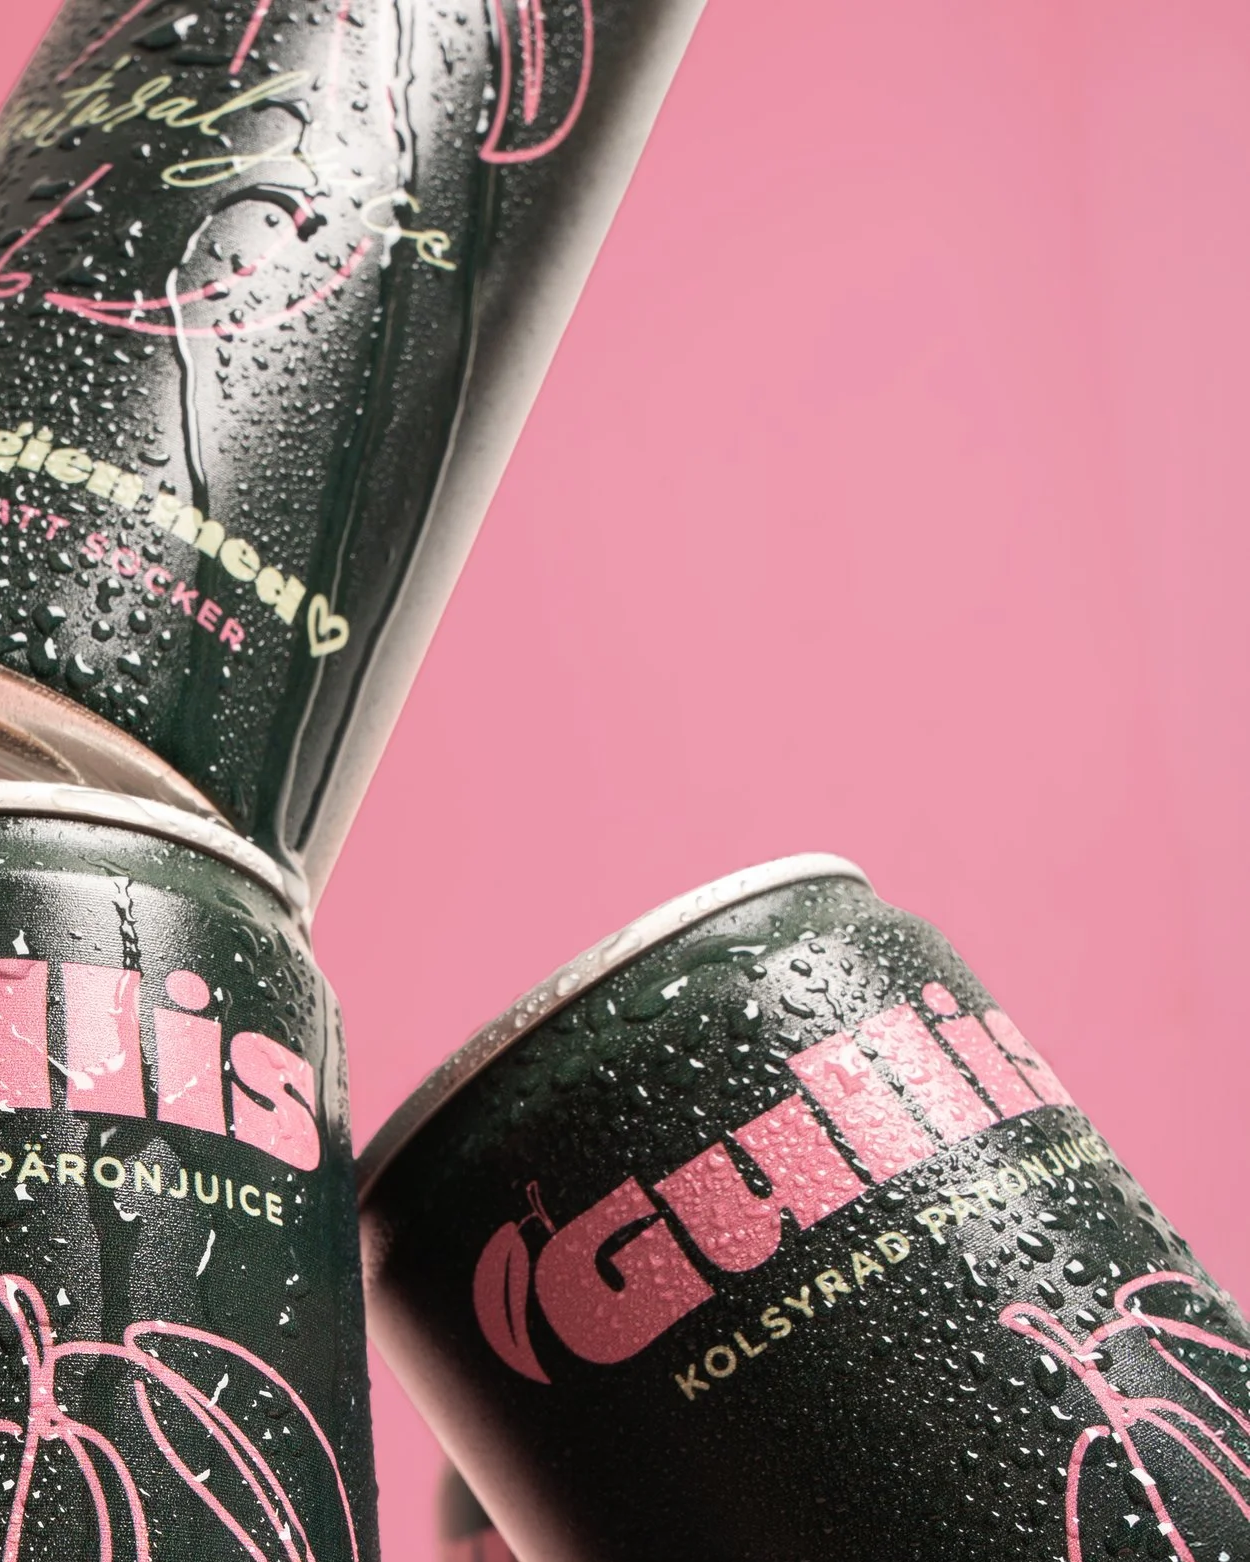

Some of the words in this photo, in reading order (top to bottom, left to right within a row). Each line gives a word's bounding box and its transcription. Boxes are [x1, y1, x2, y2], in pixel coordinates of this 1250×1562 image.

[81, 531, 246, 651] SOCKER
[151, 493, 307, 625] med
[674, 1230, 912, 1401] KOLSYRAD
